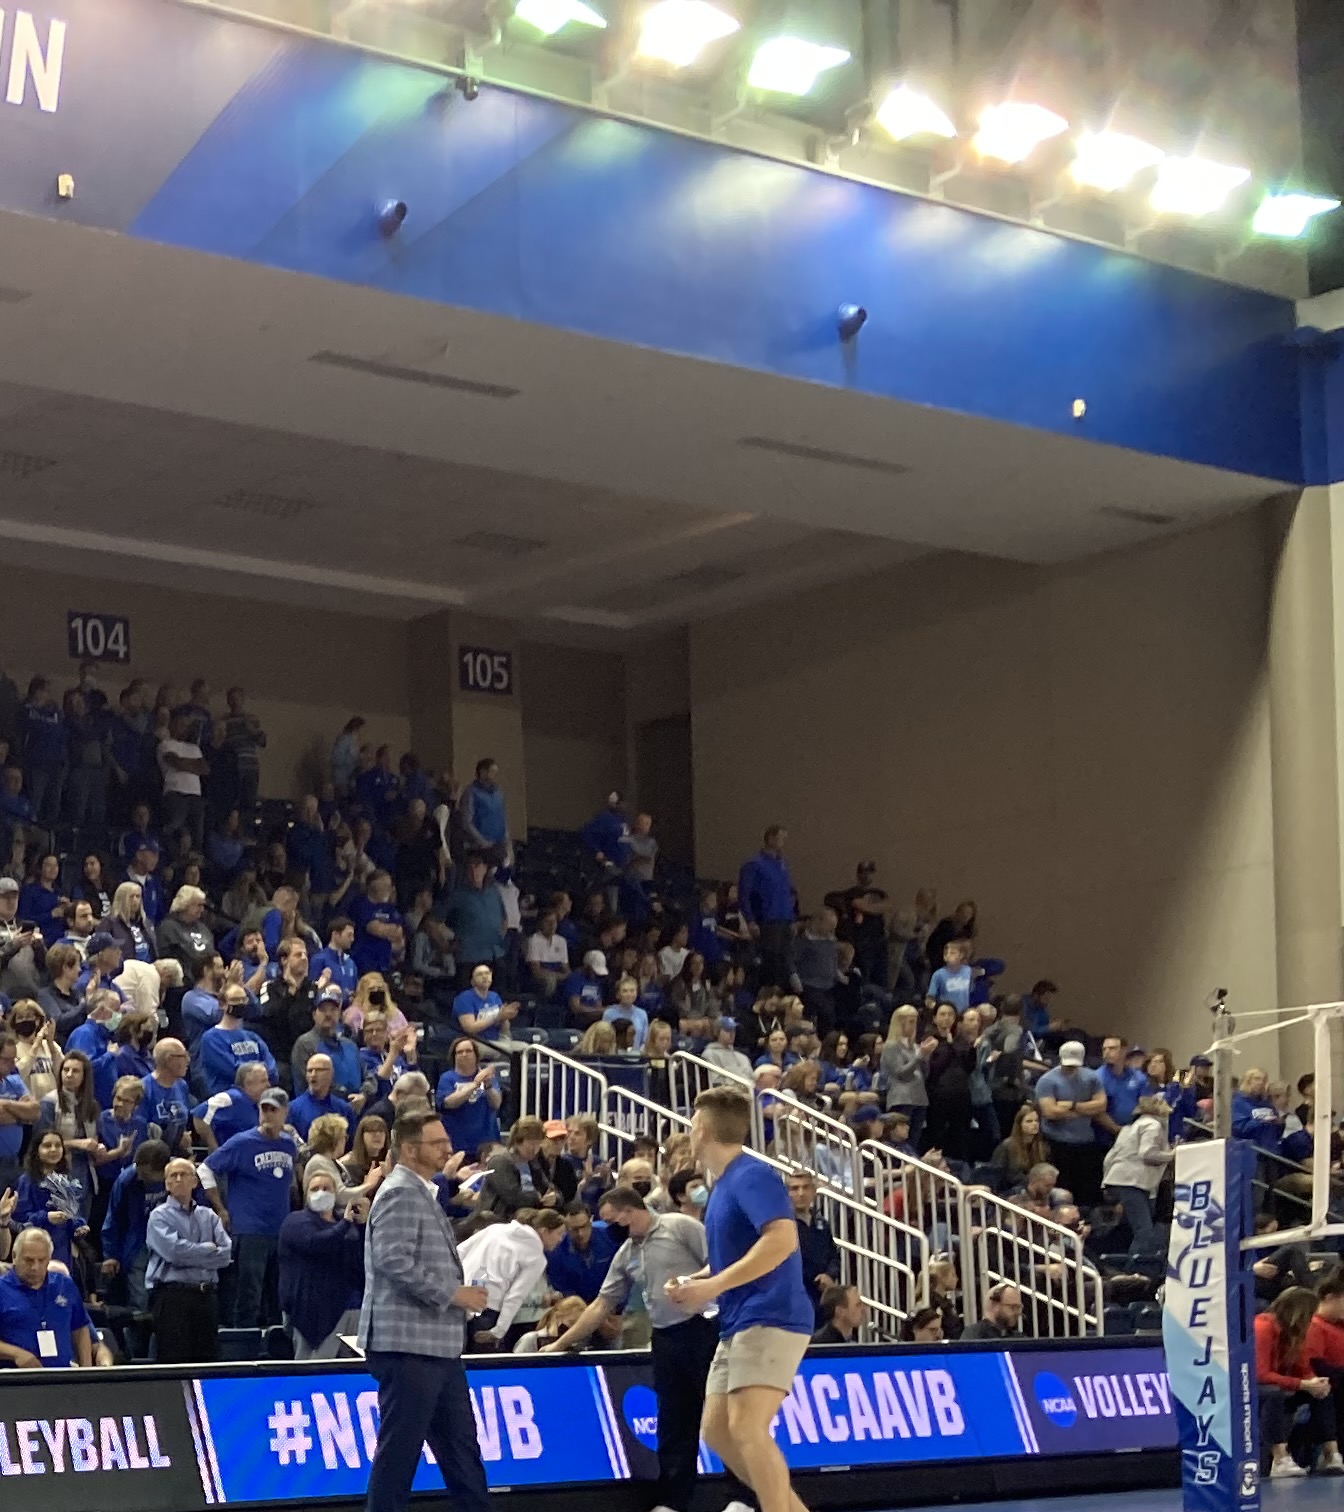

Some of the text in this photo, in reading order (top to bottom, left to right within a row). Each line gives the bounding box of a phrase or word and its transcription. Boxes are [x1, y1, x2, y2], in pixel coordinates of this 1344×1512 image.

[70, 616, 129, 660] 104
[462, 650, 510, 691] 105
[1188, 1180, 1221, 1485] BLUEJAYS
[769, 1369, 966, 1445] NCAAVB
